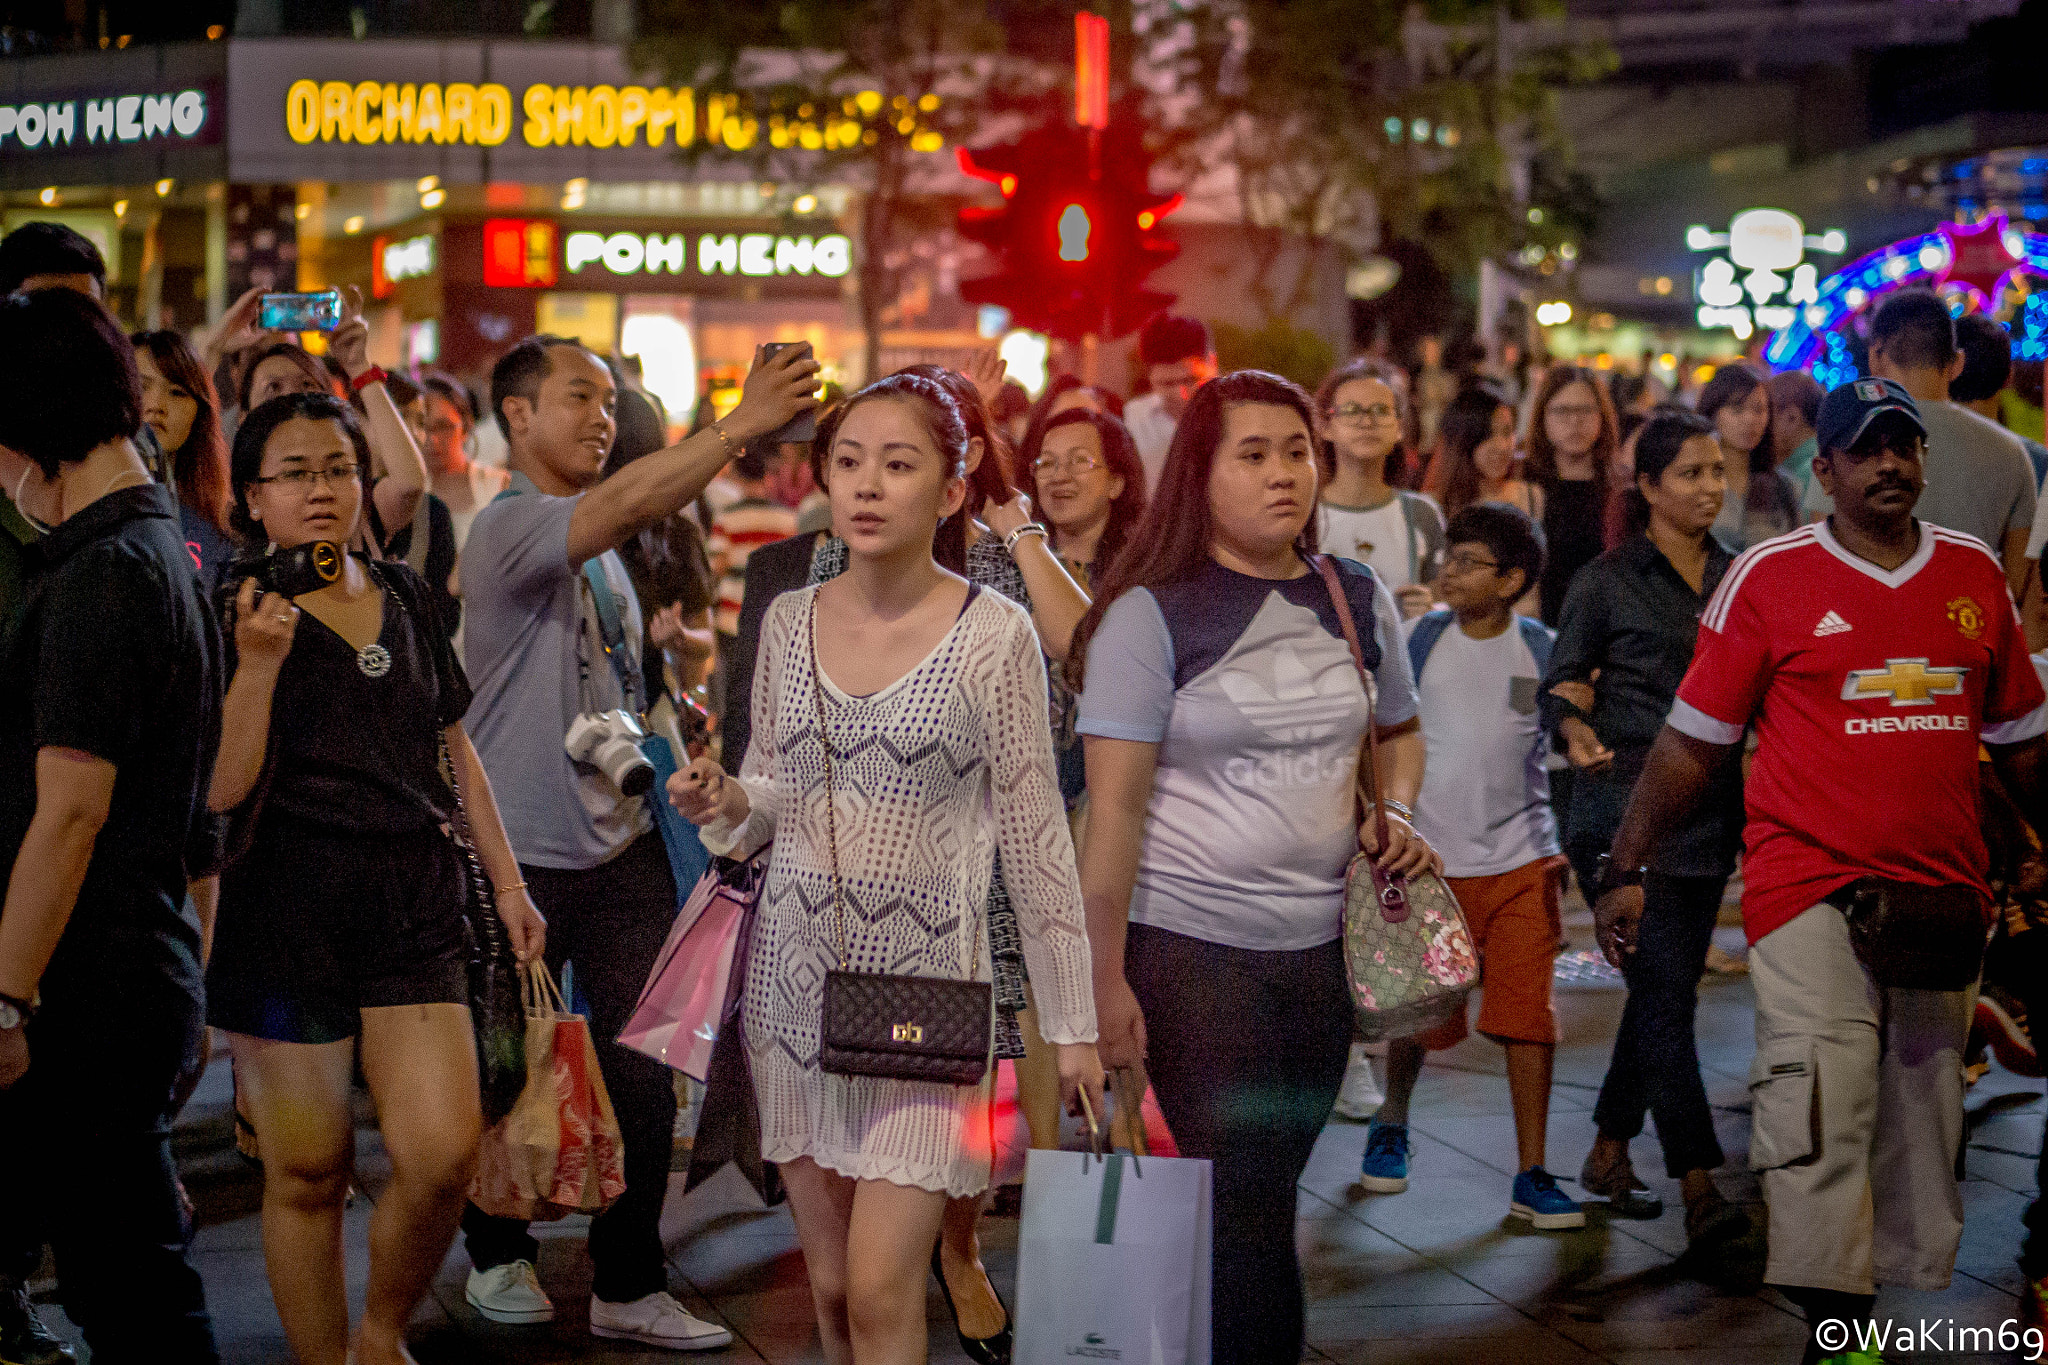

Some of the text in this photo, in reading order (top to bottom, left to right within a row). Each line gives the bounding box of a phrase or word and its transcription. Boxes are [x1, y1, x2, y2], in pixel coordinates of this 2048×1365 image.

[85, 89, 206, 143] HENG
[286, 79, 512, 146] ORCHARD
[565, 231, 853, 277] POH HENG
[1844, 714, 1970, 735] CHEVROLE
